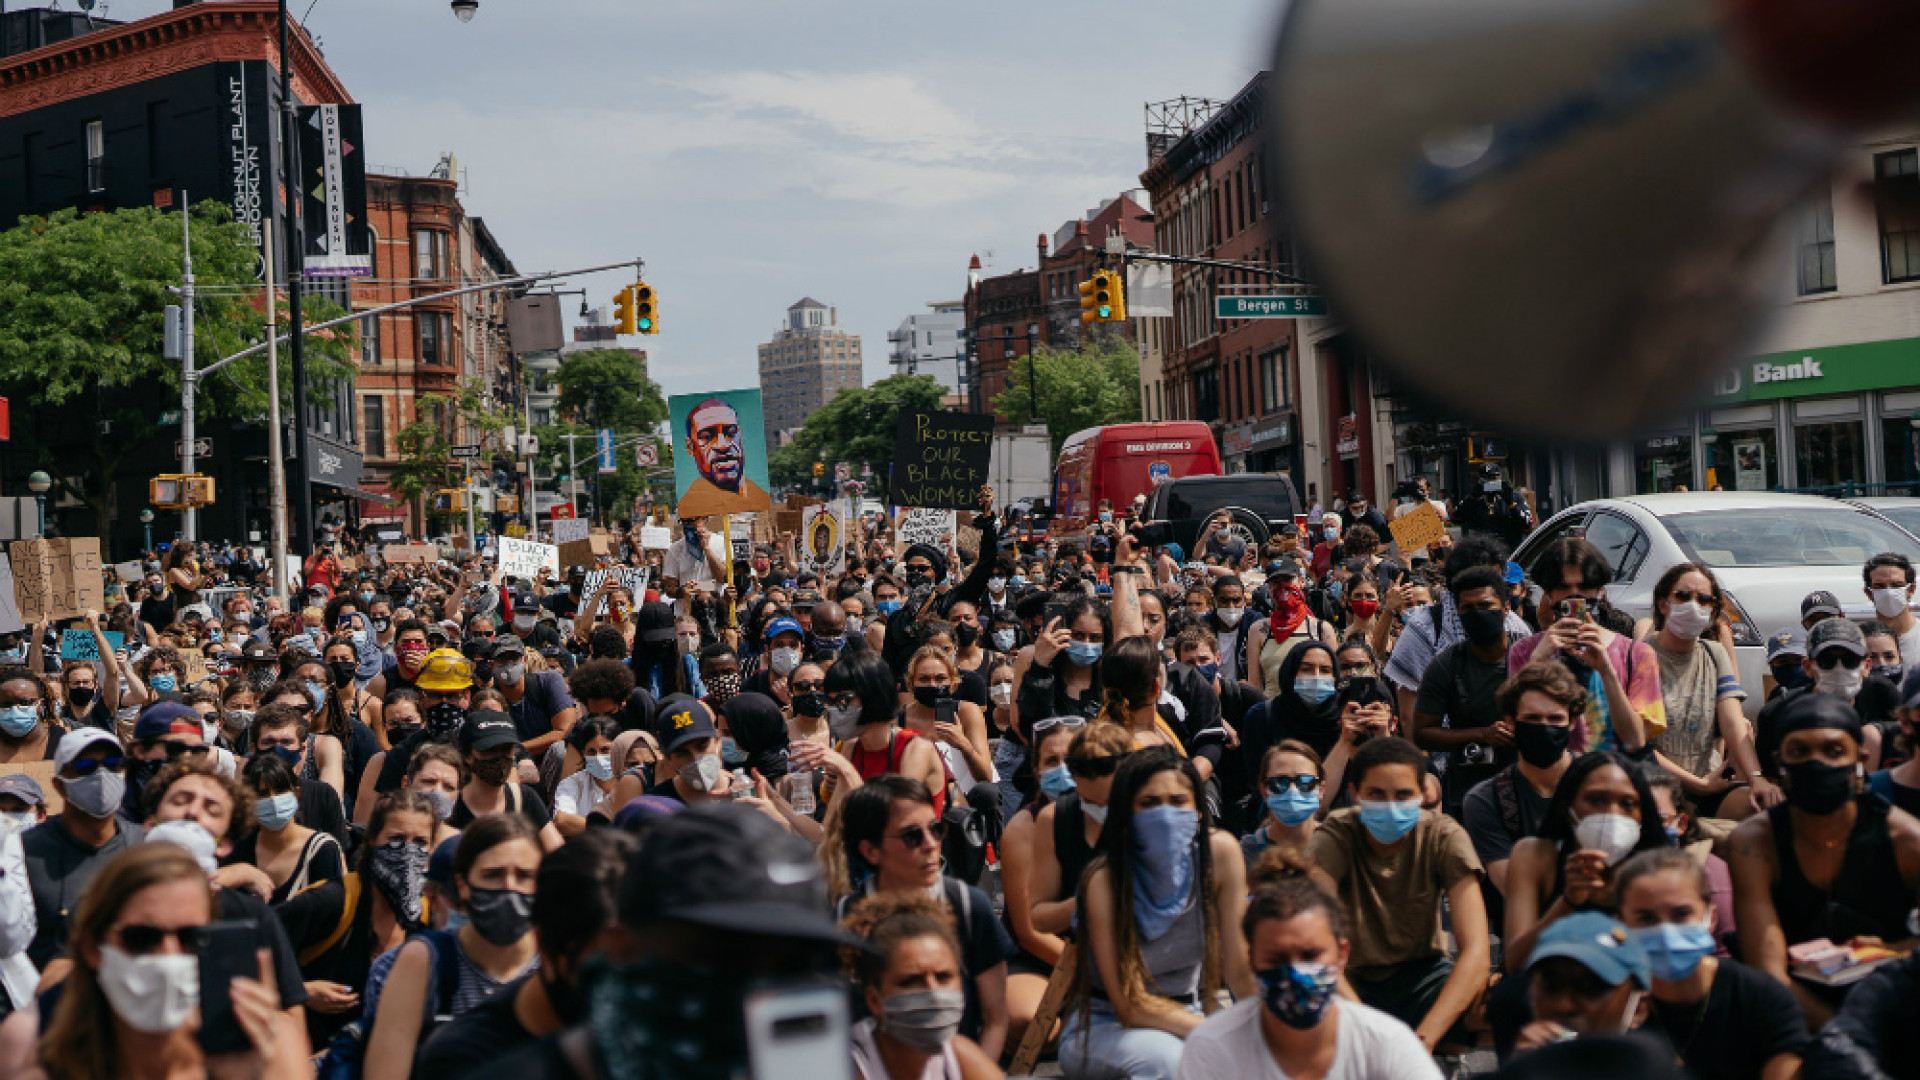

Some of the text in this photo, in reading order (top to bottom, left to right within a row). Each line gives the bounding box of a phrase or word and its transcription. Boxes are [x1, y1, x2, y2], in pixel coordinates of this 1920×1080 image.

[230, 76, 244, 140] PLANT
[325, 107, 337, 157] NORTH
[247, 146, 262, 246] BROOKLYN
[1237, 299, 1309, 315] Bergen St
[1753, 356, 1824, 384] Bank
[916, 414, 992, 443] PROTECT
[923, 446, 965, 463] OUR
[1145, 441, 1184, 452] DIVISION
[907, 463, 980, 482] BLACK
[901, 484, 979, 505] WOMEN
[14, 540, 45, 558] NO
[507, 540, 551, 558] BLACK
[14, 551, 98, 578] JUSTICE
[22, 588, 92, 616] PEACE
[671, 710, 694, 730] M
